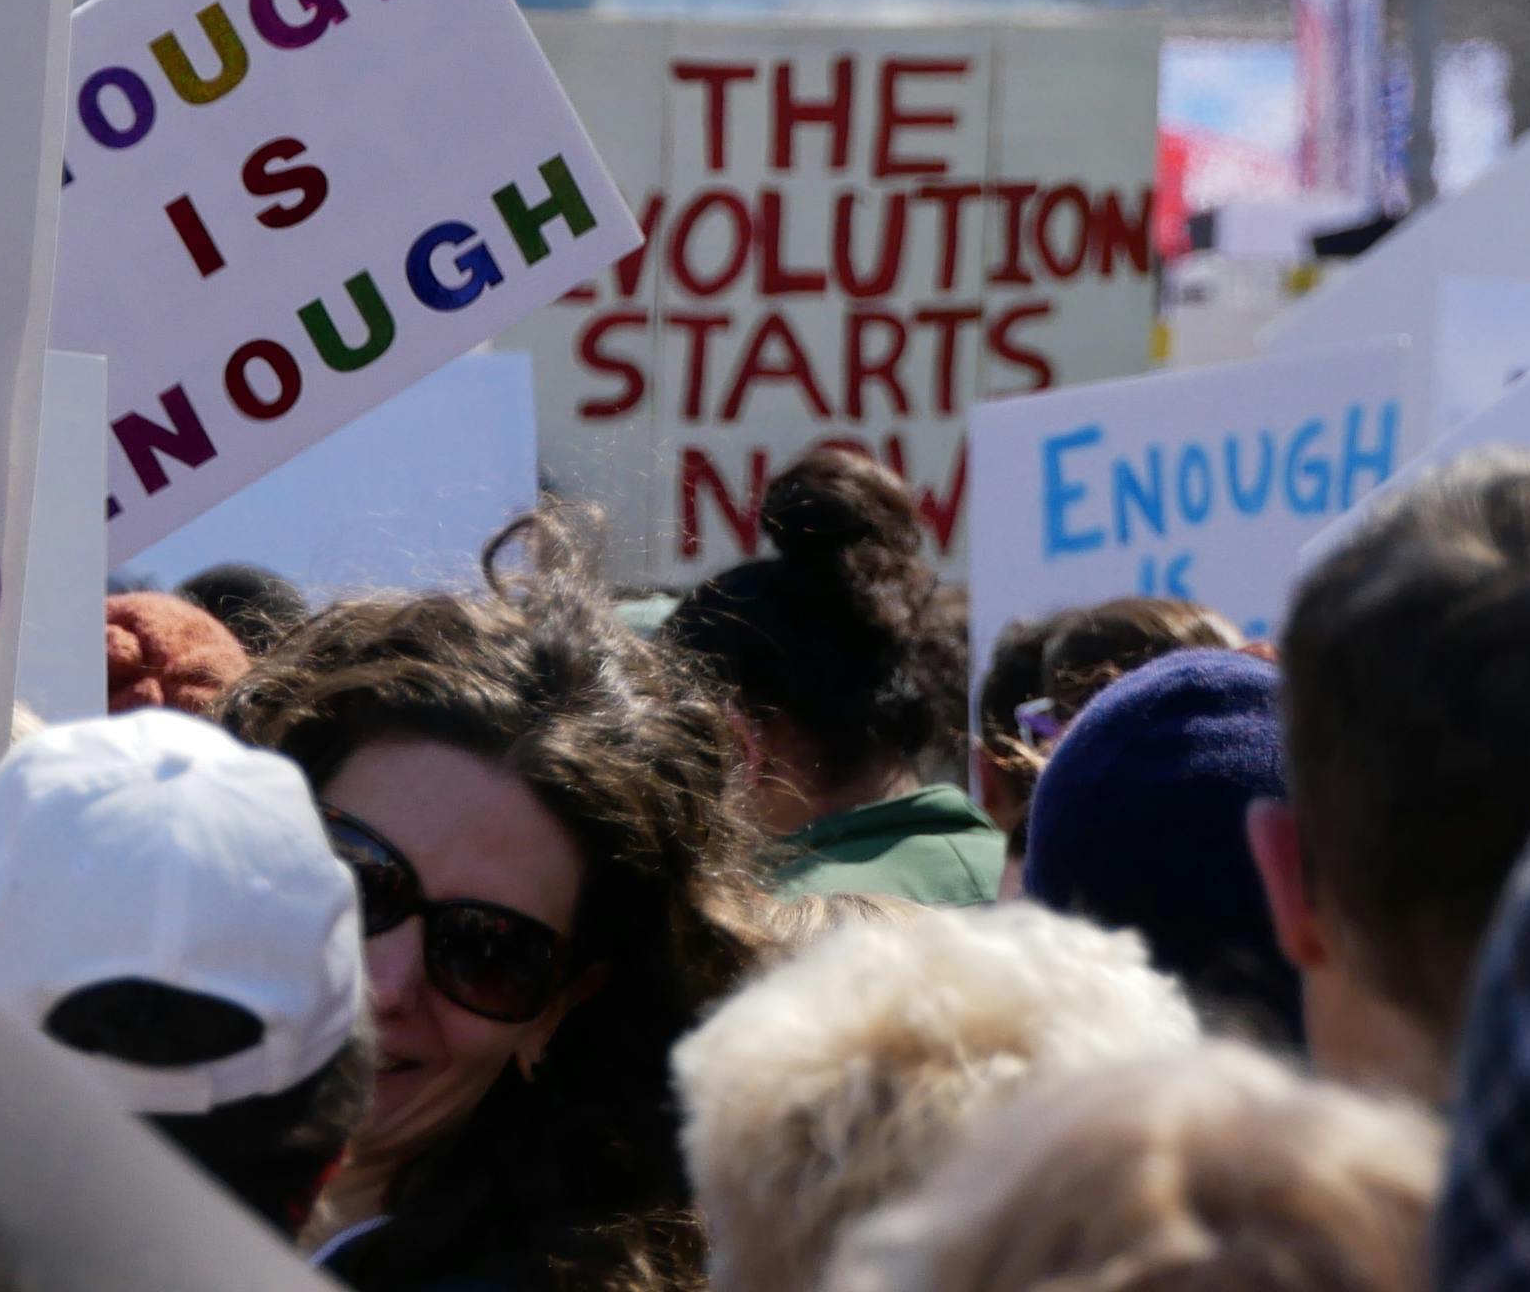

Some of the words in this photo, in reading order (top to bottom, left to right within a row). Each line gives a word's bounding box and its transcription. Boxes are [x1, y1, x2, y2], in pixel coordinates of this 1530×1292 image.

[669, 54, 973, 179] THE
[164, 136, 329, 279] IS
[557, 176, 1155, 300] VOLUTION
[105, 153, 599, 521] NOUGH
[575, 301, 1057, 422] STARTS
[678, 432, 969, 558] NW
[1040, 400, 1403, 562] ENOUGH
